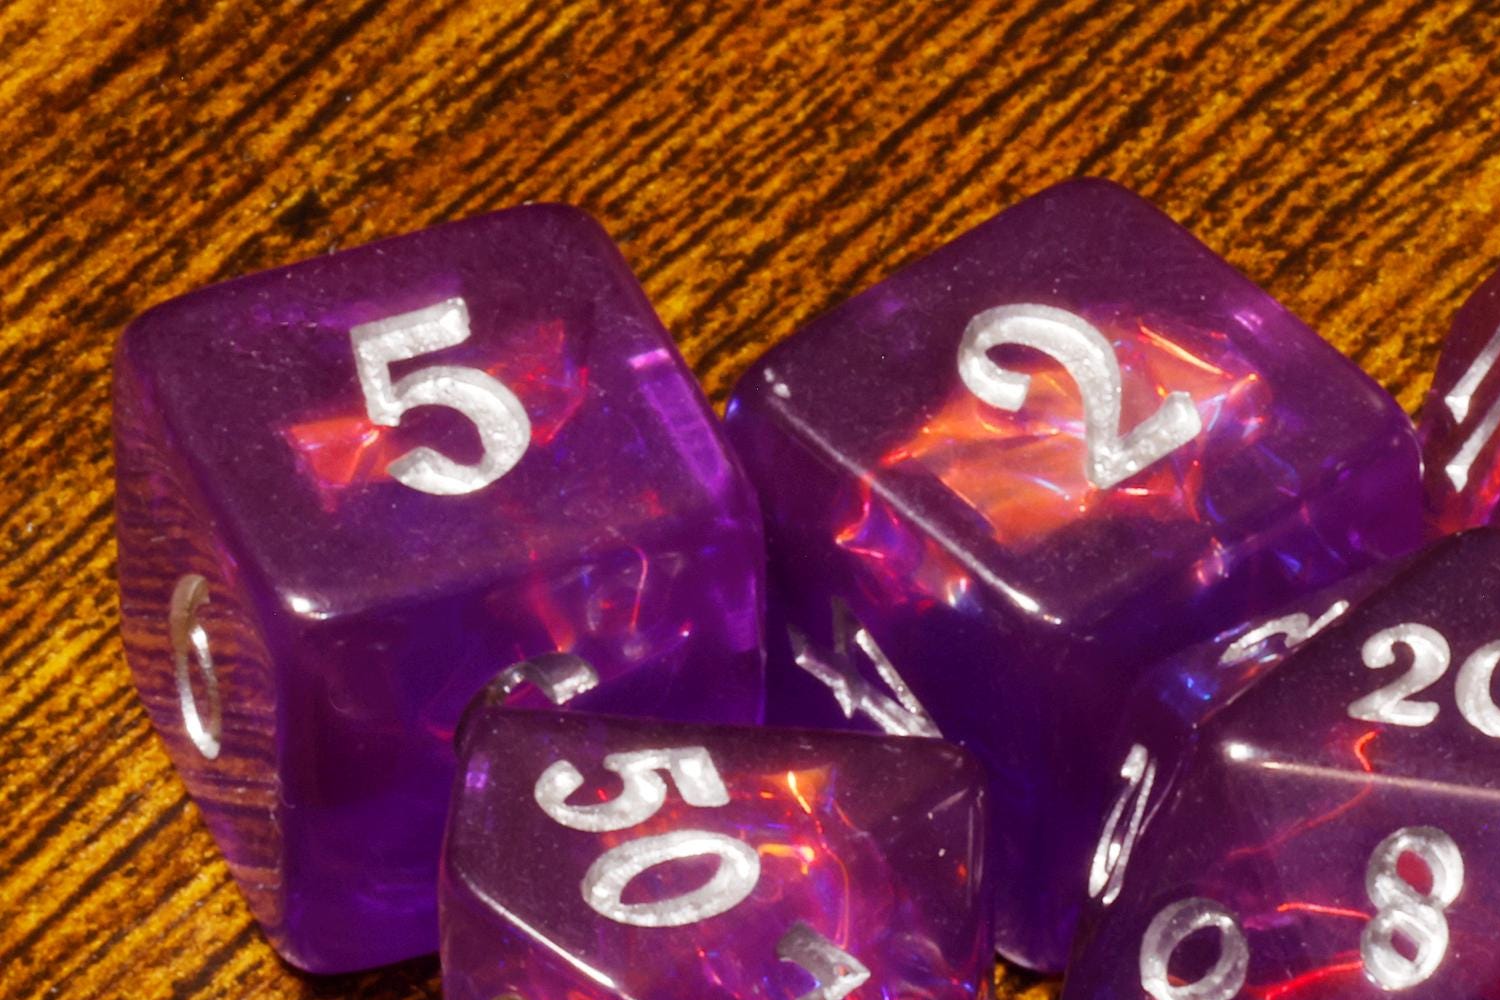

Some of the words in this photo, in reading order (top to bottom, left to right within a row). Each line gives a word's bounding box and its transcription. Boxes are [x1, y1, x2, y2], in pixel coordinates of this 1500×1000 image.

[350, 296, 532, 496] 5
[957, 302, 1201, 490] 2
[534, 746, 761, 928] 50
[1362, 826, 1465, 992] 8
